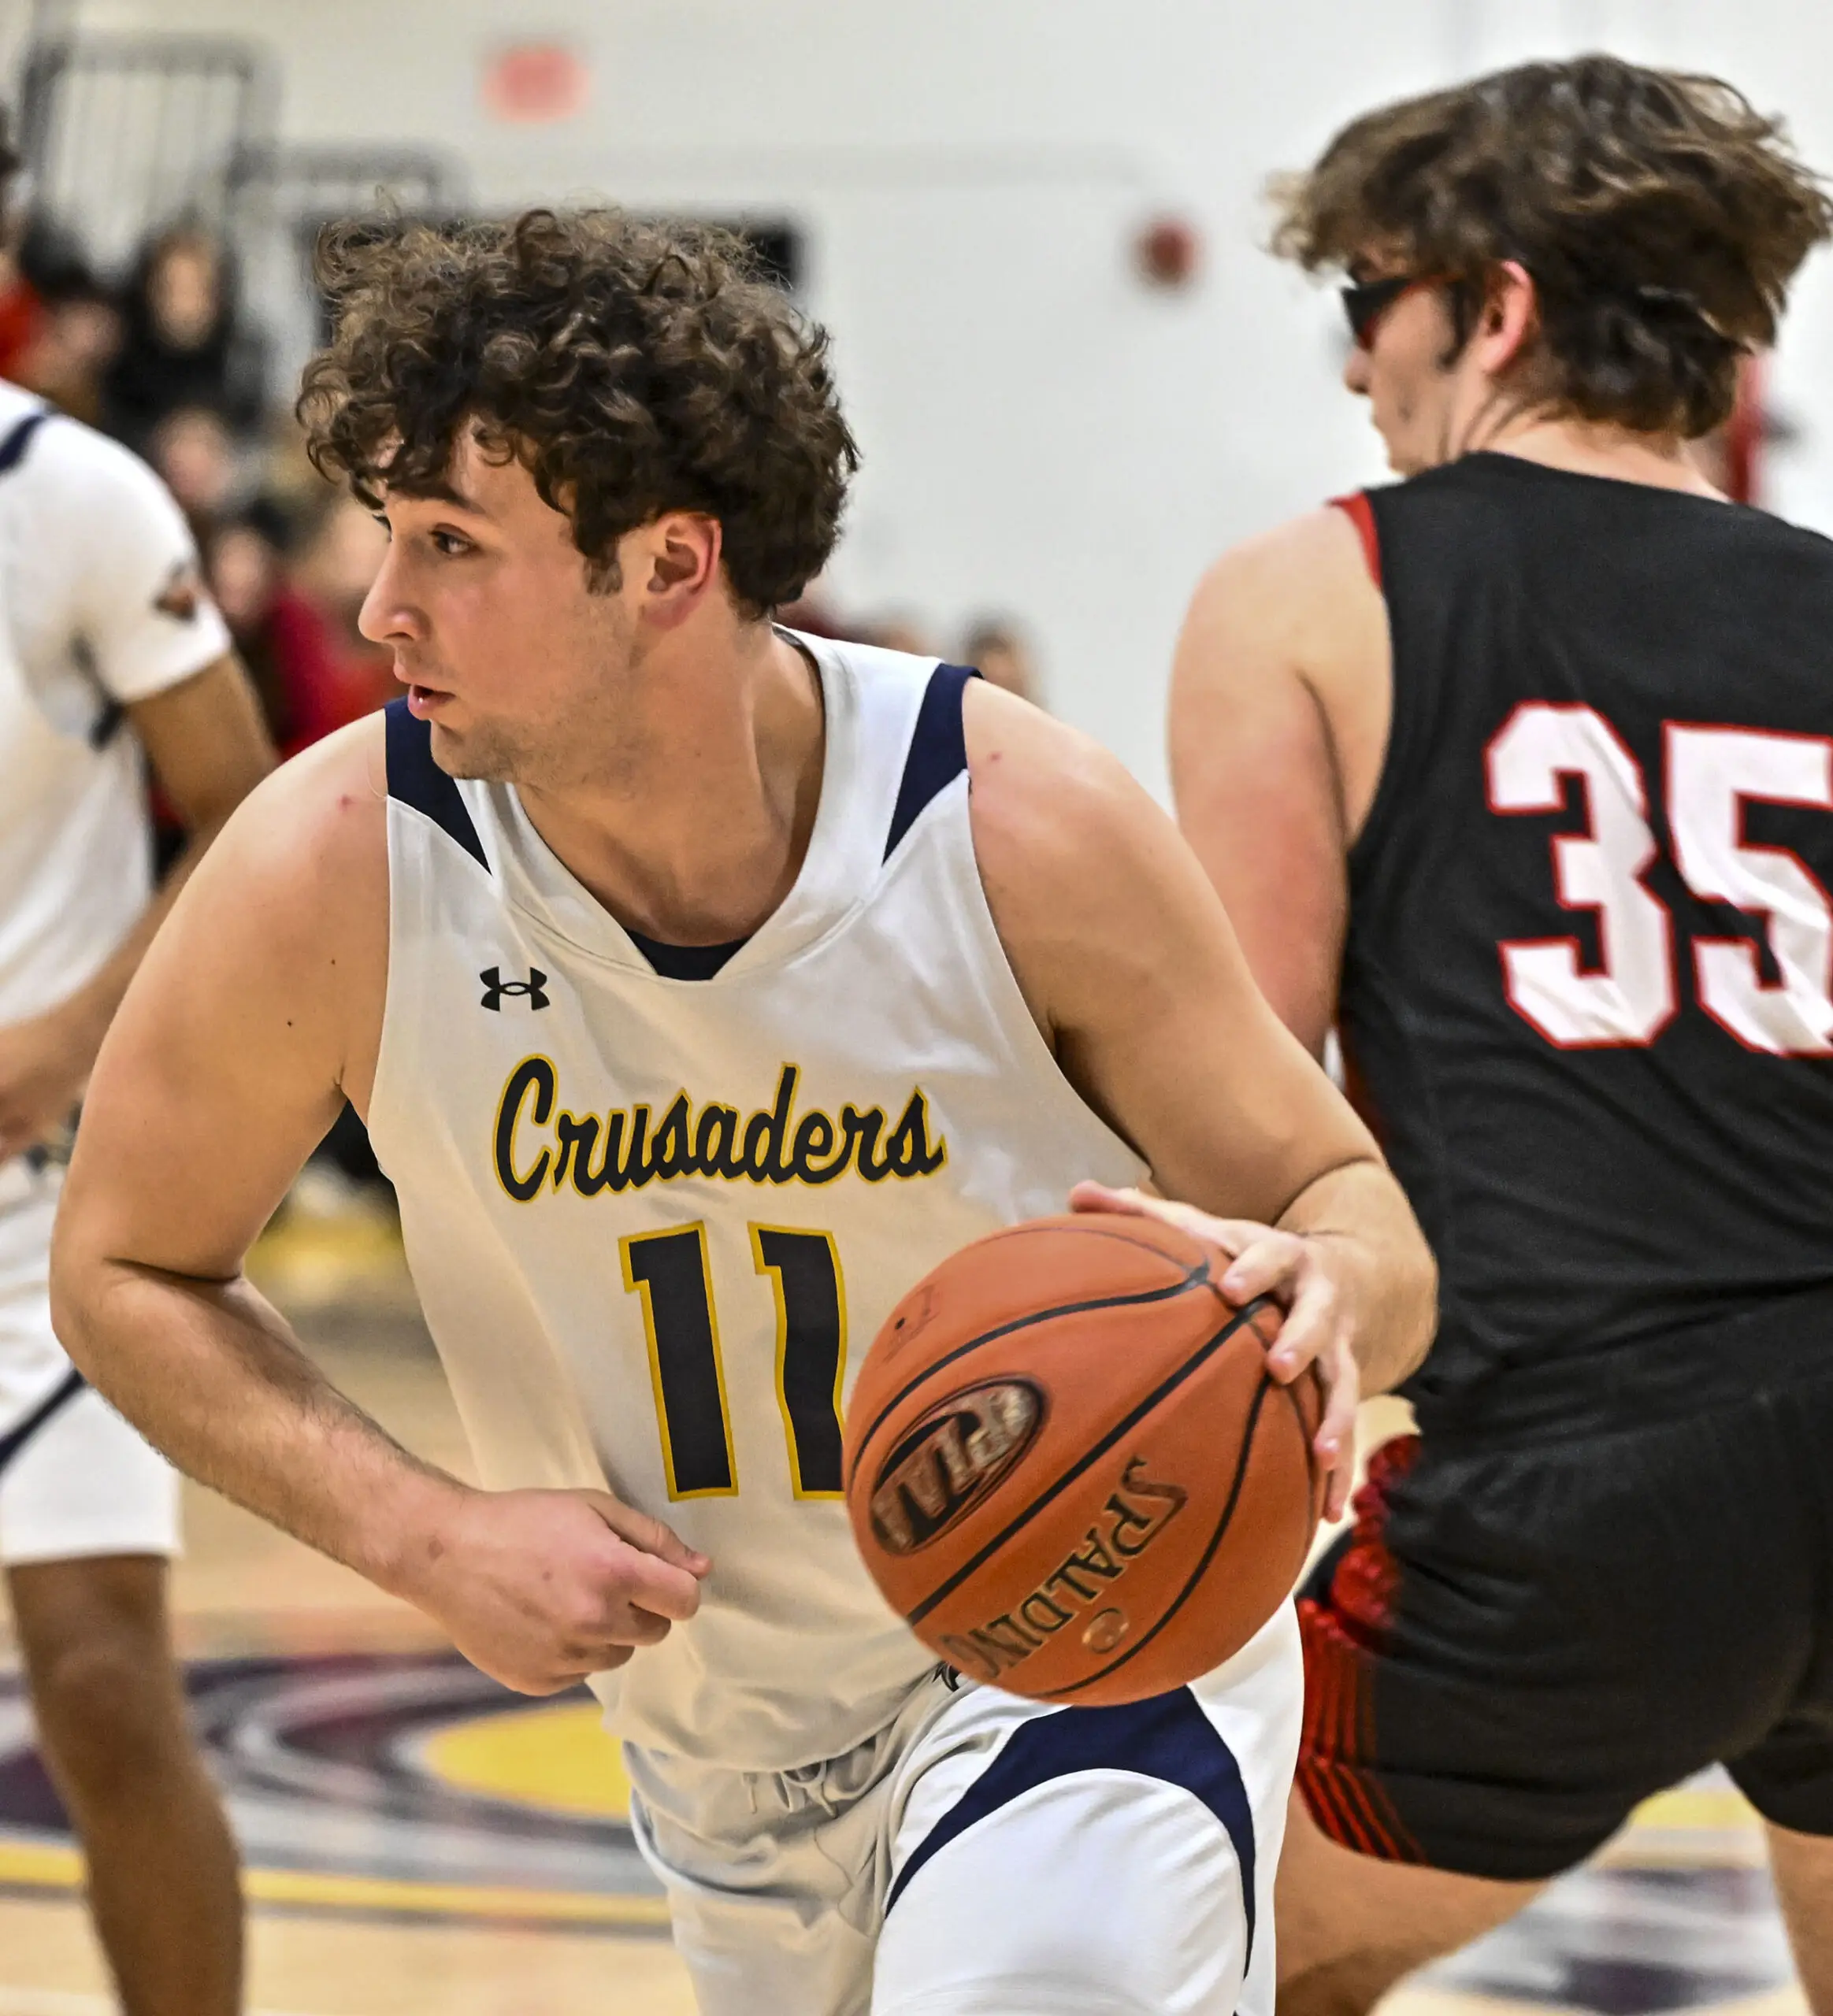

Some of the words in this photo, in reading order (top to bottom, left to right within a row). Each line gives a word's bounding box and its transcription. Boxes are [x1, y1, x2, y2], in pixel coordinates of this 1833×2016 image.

[1482, 699, 1833, 1059] 35
[493, 1053, 946, 1203] Crusaders
[618, 1220, 845, 1502] 11
